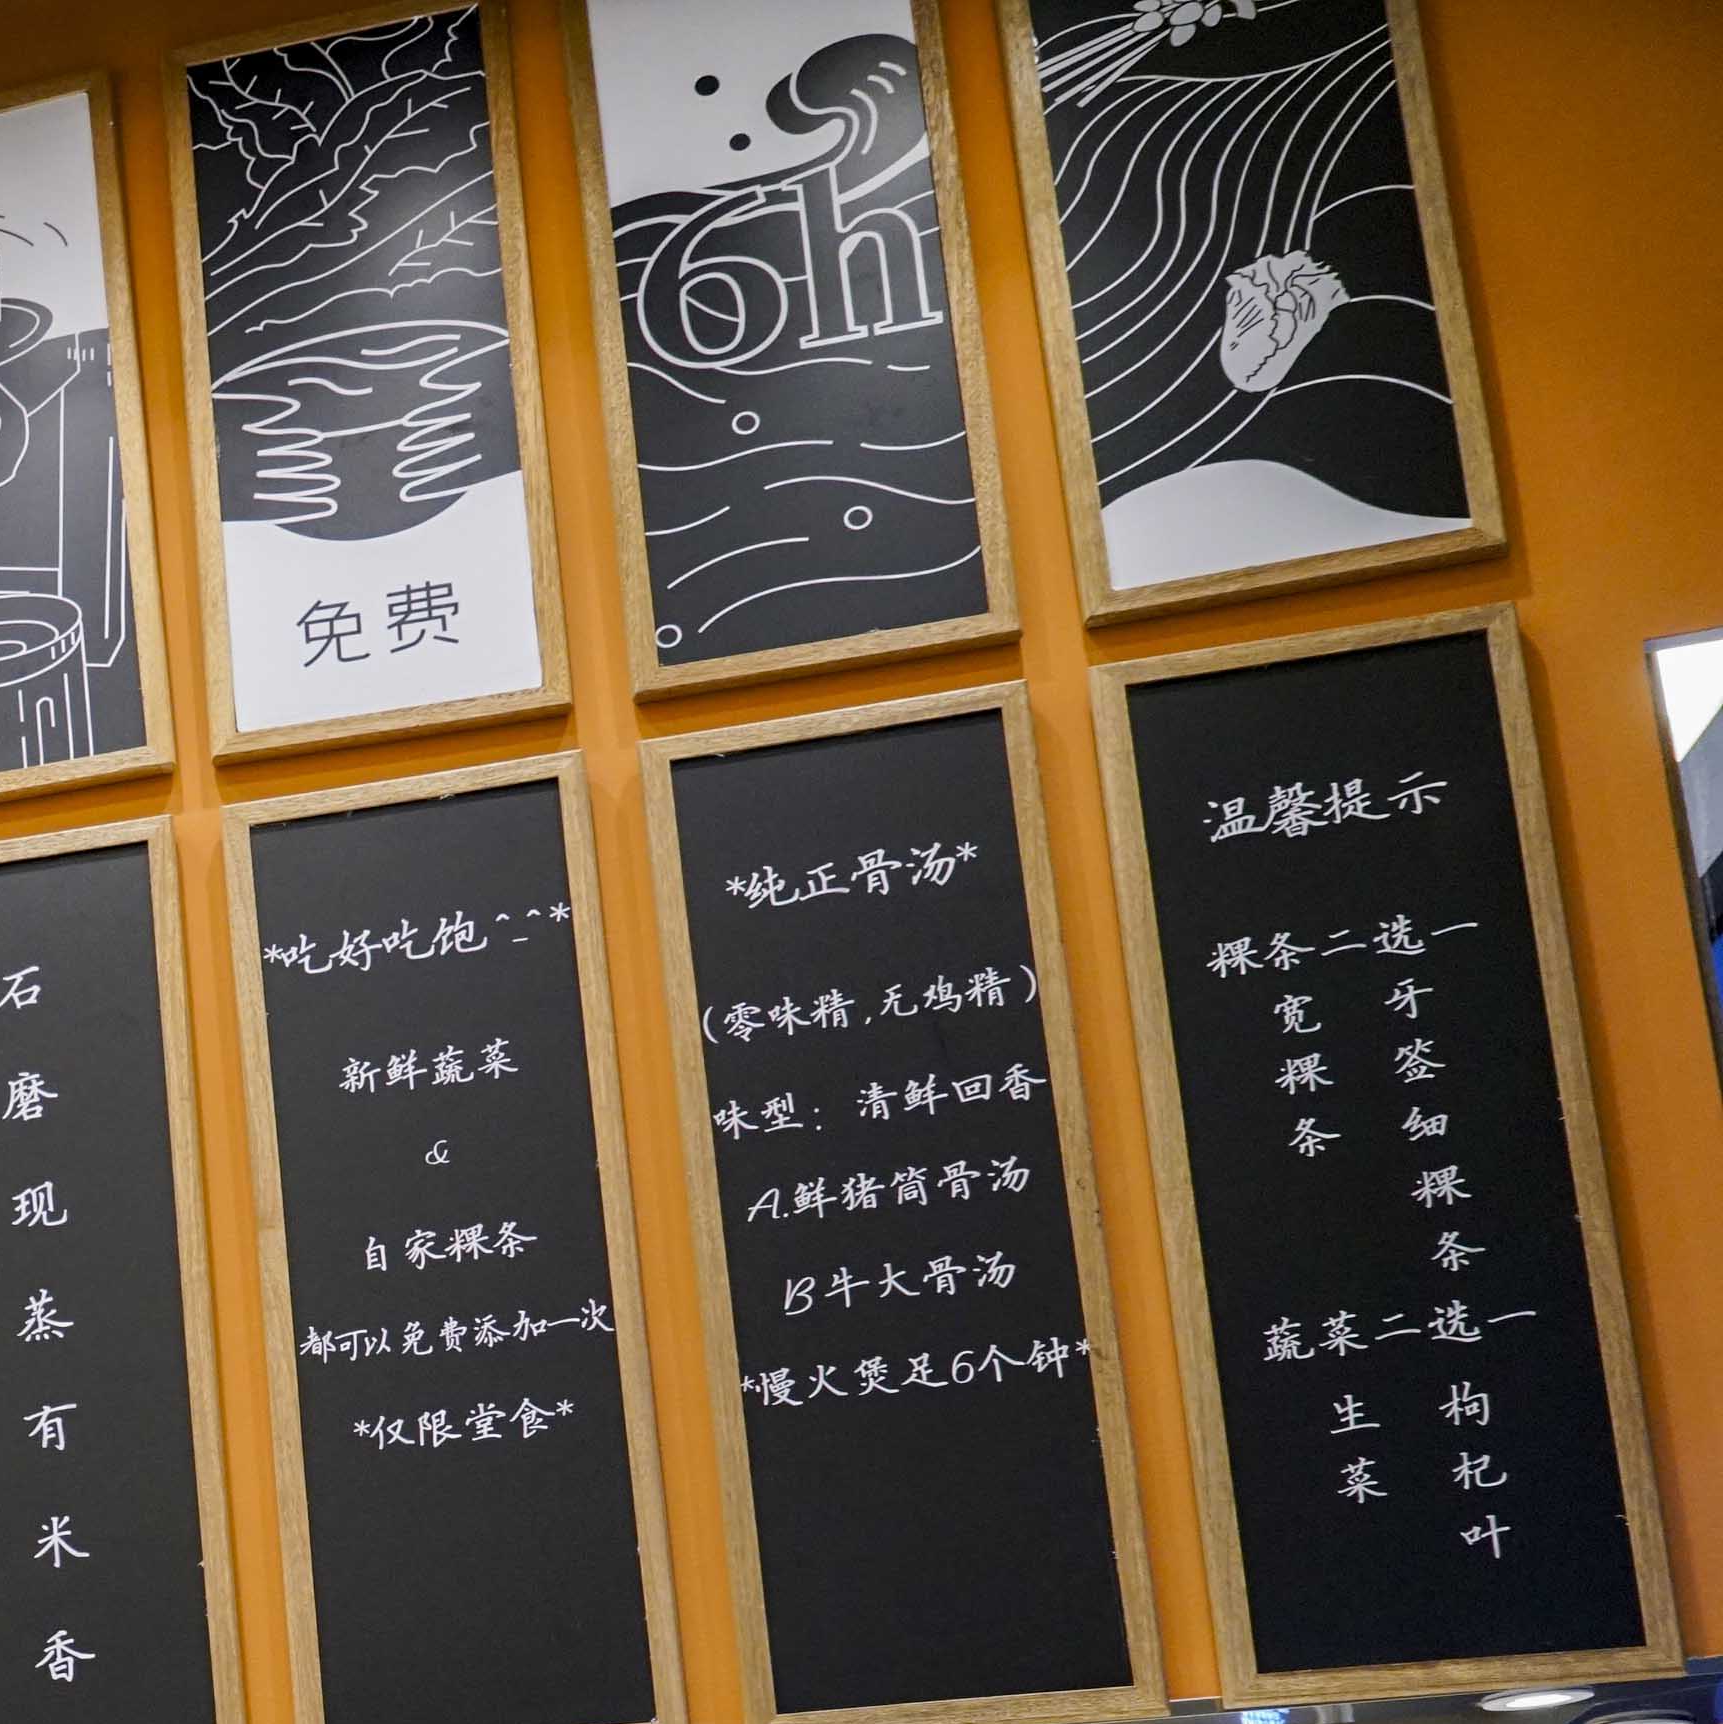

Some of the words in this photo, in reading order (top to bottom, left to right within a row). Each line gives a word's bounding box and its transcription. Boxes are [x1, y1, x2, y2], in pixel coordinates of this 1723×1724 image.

[296, 580, 459, 668] 免费
[1202, 771, 1448, 843] 温馨提示
[1206, 914, 1478, 981] 粿条二选一
[338, 1037, 519, 1093] 新鲜蔬菜
[1273, 994, 1341, 1158] 宽粿条
[424, 1139, 450, 1165] &
[1384, 977, 1486, 1272] 牙签细粿条
[747, 1155, 1030, 1223] A.鲜猪筒骨汤
[365, 1221, 538, 1272] 自家粿条
[783, 1250, 1016, 1316] B牛大骨汤
[299, 1298, 614, 1363] 都可以免费添加一次
[1263, 1299, 1537, 1362] 蔬菜二选一
[1330, 1394, 1388, 1504] 生菜
[1438, 1381, 1511, 1559] 枸杞叶
